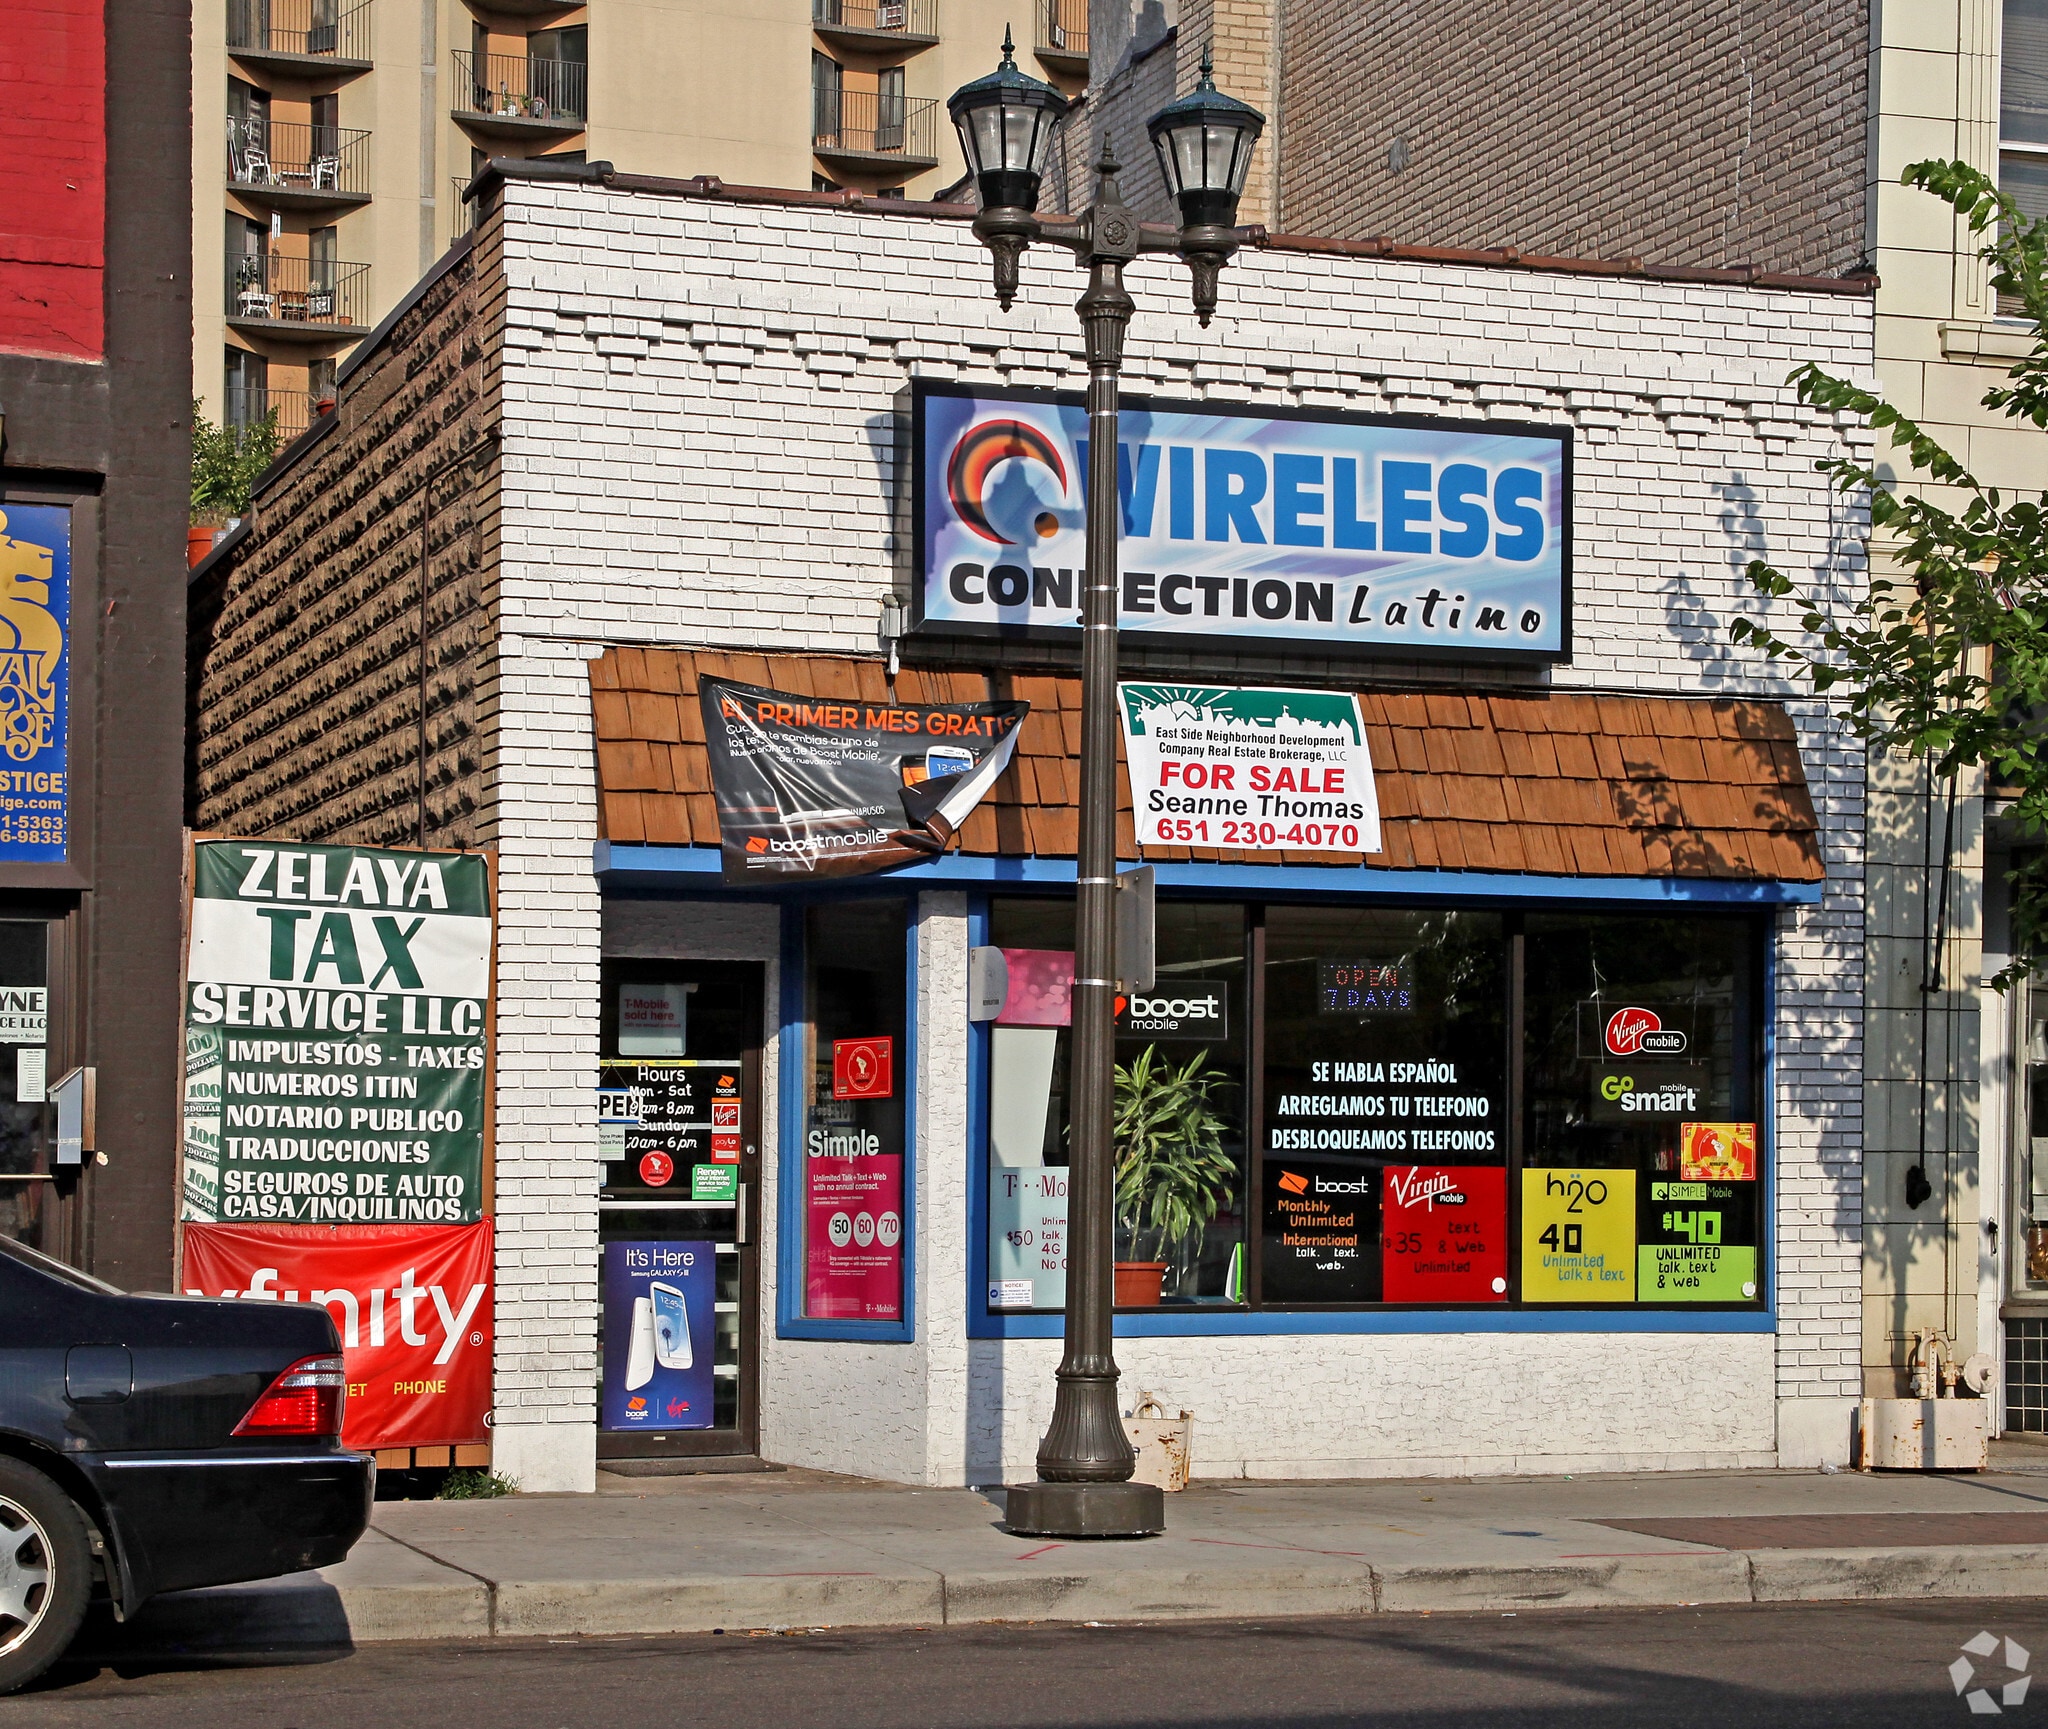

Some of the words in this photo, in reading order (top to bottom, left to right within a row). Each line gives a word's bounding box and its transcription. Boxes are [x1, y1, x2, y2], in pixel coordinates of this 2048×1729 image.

[1077, 440, 1543, 561] WIRELESS
[949, 563, 1333, 623] CONECTION
[1348, 585, 1541, 634] Latino
[757, 703, 859, 730] PRIMER
[865, 708, 920, 734] MES
[768, 731, 780, 741] te
[782, 733, 828, 746] cambias
[830, 738, 839, 746] a
[841, 739, 863, 747] uno
[865, 738, 879, 747] de
[1156, 727, 1178, 739] East
[1181, 728, 1203, 740] Side
[1206, 730, 1275, 745] Neighborhood
[1279, 734, 1345, 748] Development
[728, 738, 745, 748] los
[793, 747, 808, 756] de
[810, 747, 840, 759] Boost
[1159, 742, 1205, 759] Company
[1208, 744, 1231, 757] Real
[1234, 746, 1266, 758] Estate
[1269, 748, 1325, 762] Brokerage,
[1328, 750, 1348, 762] LLC
[1159, 761, 1235, 790] FOR
[1249, 765, 1345, 794] SALE
[1148, 789, 1248, 815] Seanne
[1257, 795, 1364, 819] Thomas
[0, 815, 63, 830] 1-5363
[1157, 818, 1209, 841] 651
[1222, 821, 1359, 847] 230-4070
[238, 849, 448, 909] ZELAYA
[256, 907, 426, 991] TAX
[1336, 969, 1397, 986] OPEN
[1130, 994, 1219, 1019] boost
[1327, 989, 1337, 1006] 7
[1348, 989, 1410, 1007] DAYS
[191, 982, 388, 1033] SERVICE
[402, 997, 482, 1036] LLC
[624, 1011, 647, 1021] sold
[650, 1011, 674, 1021] here
[21, 1017, 47, 1029] LLC
[1131, 1018, 1179, 1030] mobile
[1613, 1011, 1650, 1049] Virgin
[187, 1033, 213, 1054] 00
[1646, 1035, 1680, 1047] mobile
[228, 1039, 382, 1067] IMPUESTOS
[404, 1045, 484, 1070] TAXES
[638, 1066, 686, 1082] Hours
[1312, 1062, 1330, 1082] SE
[1334, 1062, 1385, 1082] HABLA
[1389, 1058, 1457, 1083] ESPAÑOL
[188, 1083, 222, 1098] 100
[227, 1071, 358, 1098] NUMEROS
[366, 1075, 418, 1098] ITIN
[629, 1086, 654, 1099] Mon
[668, 1084, 692, 1097] Sat
[1601, 1076, 1634, 1100] Go
[1660, 1084, 1687, 1092] mobile
[599, 1095, 640, 1116] PEN
[1278, 1095, 1385, 1116] ARREGLAMOS
[1390, 1096, 1409, 1116] TU
[1414, 1096, 1489, 1117] TELEFONO
[1621, 1088, 1696, 1111] smart
[226, 1105, 343, 1129] NOTARIO
[351, 1108, 463, 1132] PUBLICO
[637, 1118, 688, 1135] Sunday
[189, 1125, 221, 1149] 100
[667, 1136, 697, 1151] 6pm
[808, 1129, 880, 1163] Simple
[1272, 1129, 1407, 1150] DESBLOQUEAMOS
[1411, 1130, 1495, 1150] TELEFONOS
[226, 1136, 430, 1164] TRADUCCIONES
[697, 1167, 726, 1175] Renew
[223, 1171, 348, 1196] SEGUROS
[356, 1173, 388, 1196] DE
[395, 1174, 464, 1198] AUTO
[1315, 1175, 1368, 1193] boost
[1390, 1166, 1457, 1212] Virgin
[1671, 1186, 1705, 1197] SIMPLE
[1707, 1186, 1732, 1198] Mobile
[1278, 1200, 1330, 1214] Monthly
[1439, 1193, 1464, 1203] mobile
[223, 1195, 461, 1222] CASA/INQUILINOS
[1042, 1216, 1067, 1225] Unlim
[1290, 1213, 1354, 1227] Unlimited
[1448, 1221, 1481, 1235] text
[1663, 1211, 1721, 1243] $40
[1007, 1230, 1033, 1247] $50
[1283, 1232, 1358, 1247] International
[1438, 1241, 1447, 1252] &
[1539, 1224, 1582, 1253] 40
[626, 1249, 649, 1266] It's
[653, 1249, 694, 1266] Here
[1042, 1243, 1061, 1254] 4G
[1656, 1247, 1720, 1260] UNLIMITED
[1042, 1259, 1057, 1270] No
[1414, 1260, 1470, 1274] Unlimited
[1543, 1254, 1604, 1268] Unlimited
[1689, 1261, 1717, 1273] text
[1558, 1268, 1583, 1281] talk
[1599, 1268, 1626, 1281] text
[1657, 1275, 1666, 1288] &
[1673, 1276, 1700, 1287] web
[186, 1267, 487, 1364] nity
[394, 1380, 446, 1395] PHONE
